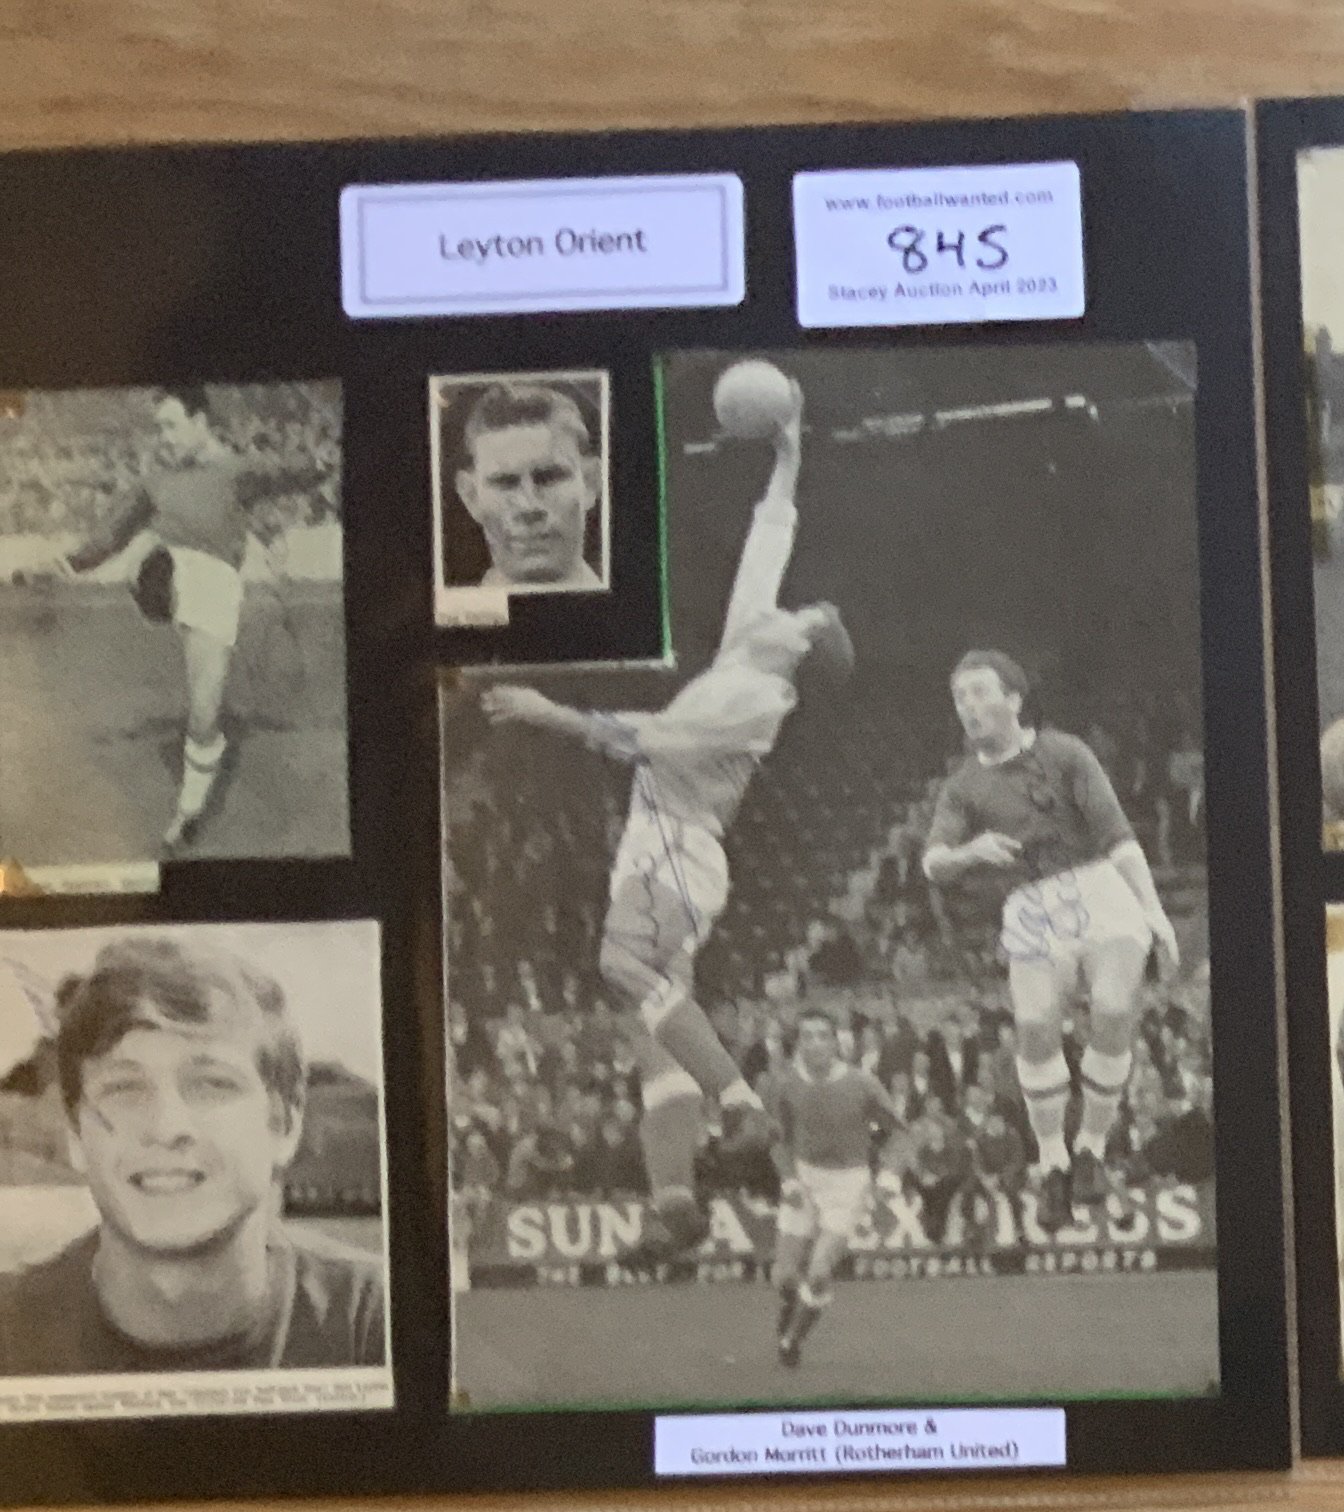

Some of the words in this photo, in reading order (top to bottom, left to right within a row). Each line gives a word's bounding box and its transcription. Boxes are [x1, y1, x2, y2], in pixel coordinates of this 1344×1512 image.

[439, 233, 544, 265] Leyton
[555, 227, 647, 255] Orient
[887, 223, 1009, 274] 845
[828, 283, 888, 302] Stacey
[894, 281, 962, 299] Auction
[969, 279, 1010, 298] April
[1016, 276, 1058, 295] 2023
[781, 1420, 828, 1438] Dave
[833, 1419, 918, 1437] Dunmore
[924, 1417, 938, 1435] &
[690, 1446, 758, 1465] Gordon
[764, 1445, 827, 1464] Morritt
[835, 1444, 945, 1465] (Rotherham
[950, 1441, 1019, 1461] United)
